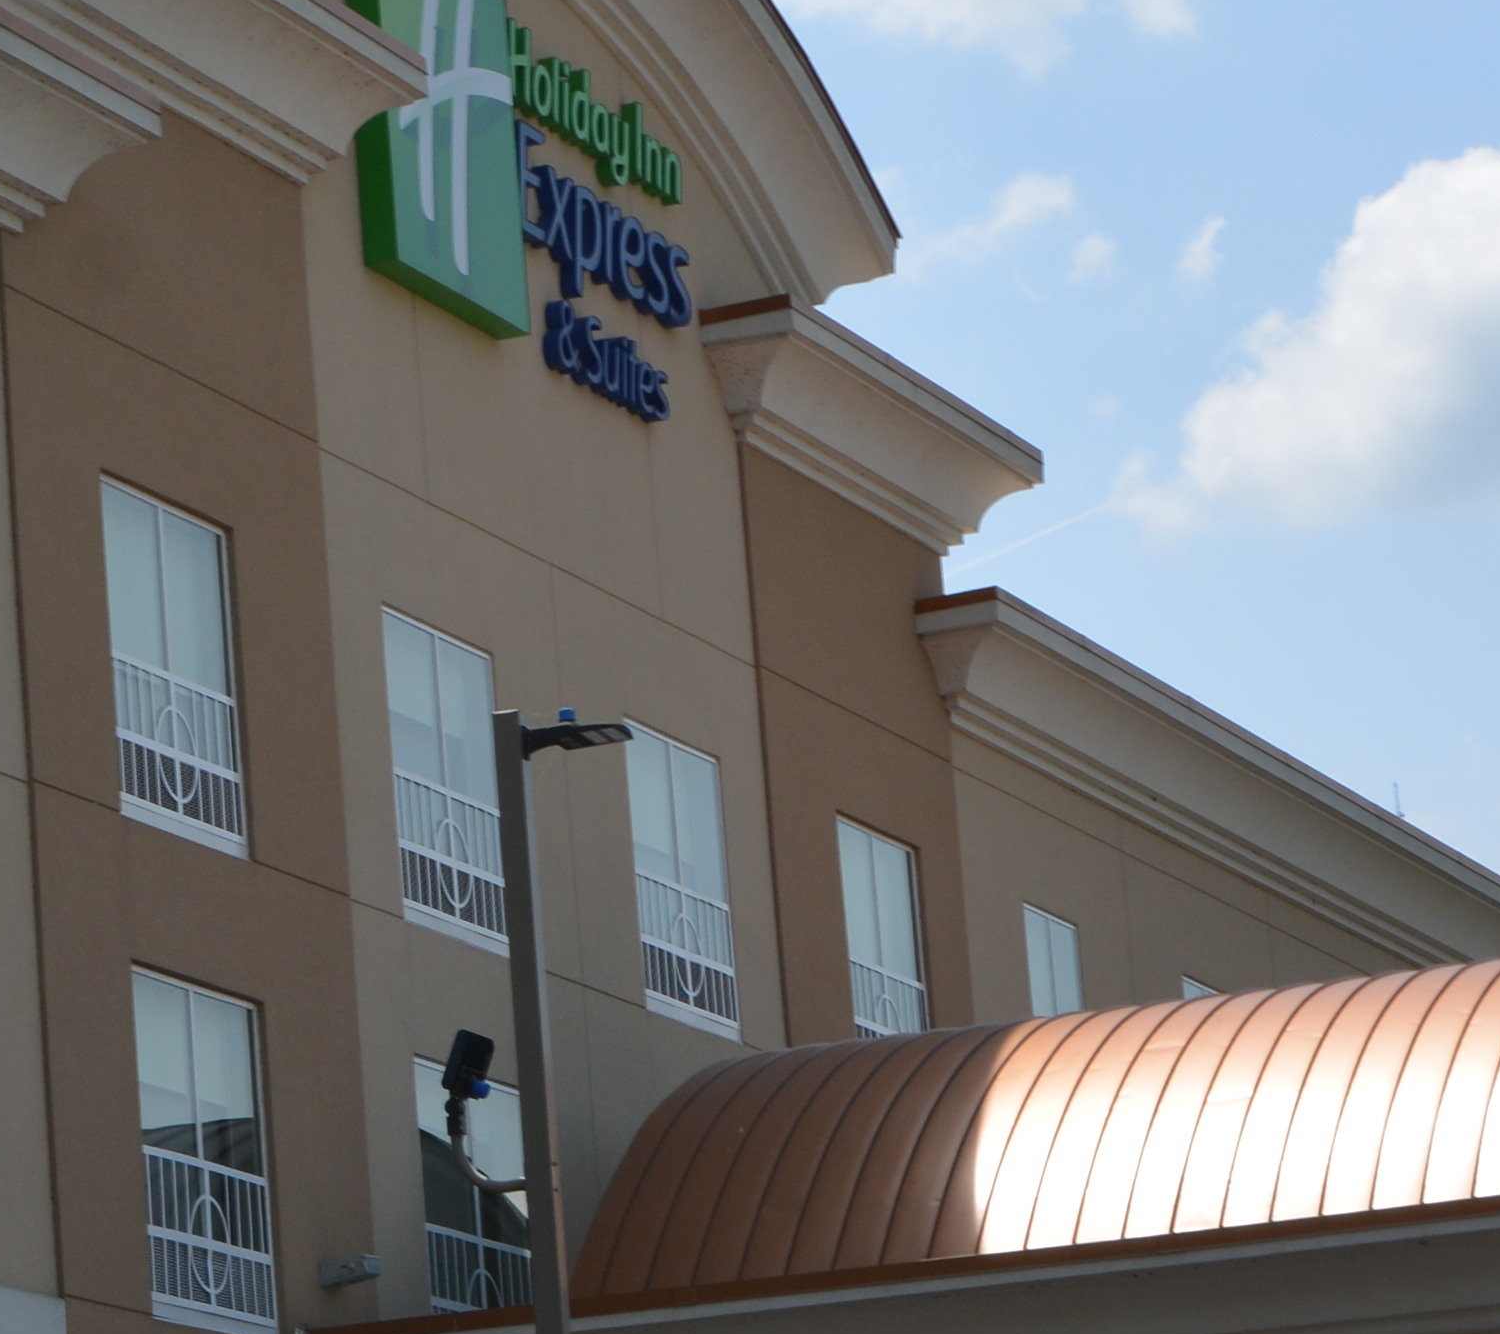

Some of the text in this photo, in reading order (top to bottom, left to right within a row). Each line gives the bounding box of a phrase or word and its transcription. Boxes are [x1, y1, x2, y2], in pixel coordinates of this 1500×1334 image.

[506, 16, 683, 206] Holiday Inn
[516, 119, 693, 329] Express
[543, 299, 671, 424] & Suites
